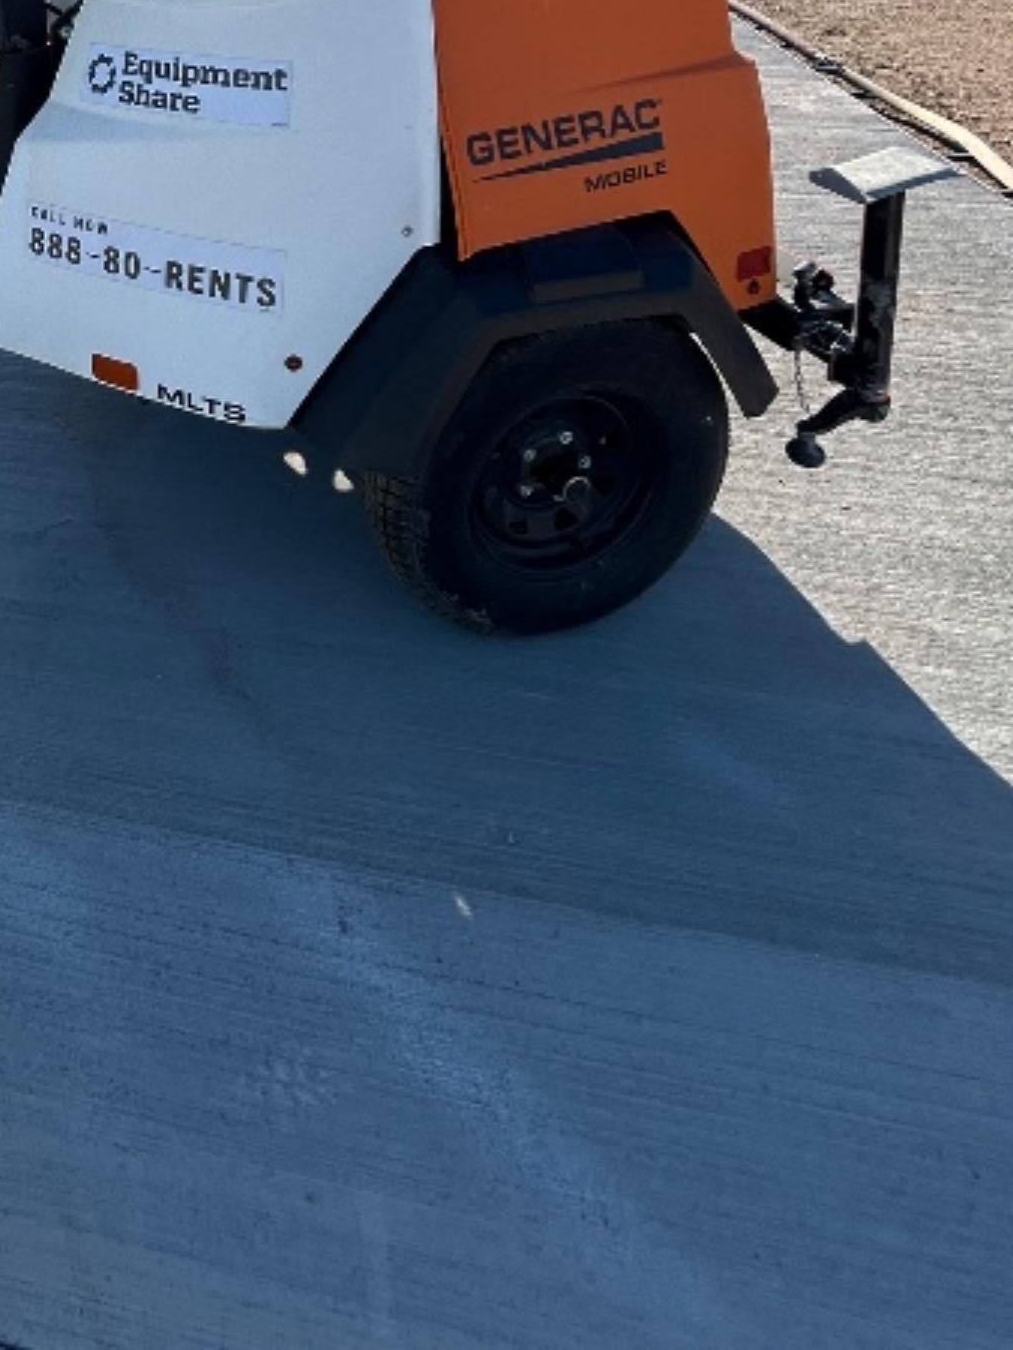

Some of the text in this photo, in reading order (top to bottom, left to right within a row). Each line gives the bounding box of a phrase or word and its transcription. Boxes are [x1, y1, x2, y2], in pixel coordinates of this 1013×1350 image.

[122, 50, 288, 91] Equipment
[118, 80, 201, 114] Share
[467, 98, 662, 166] GENERAC
[584, 161, 668, 193] MOBILE
[29, 227, 276, 308] 888-80-RENTS
[157, 383, 246, 423] MLTS
